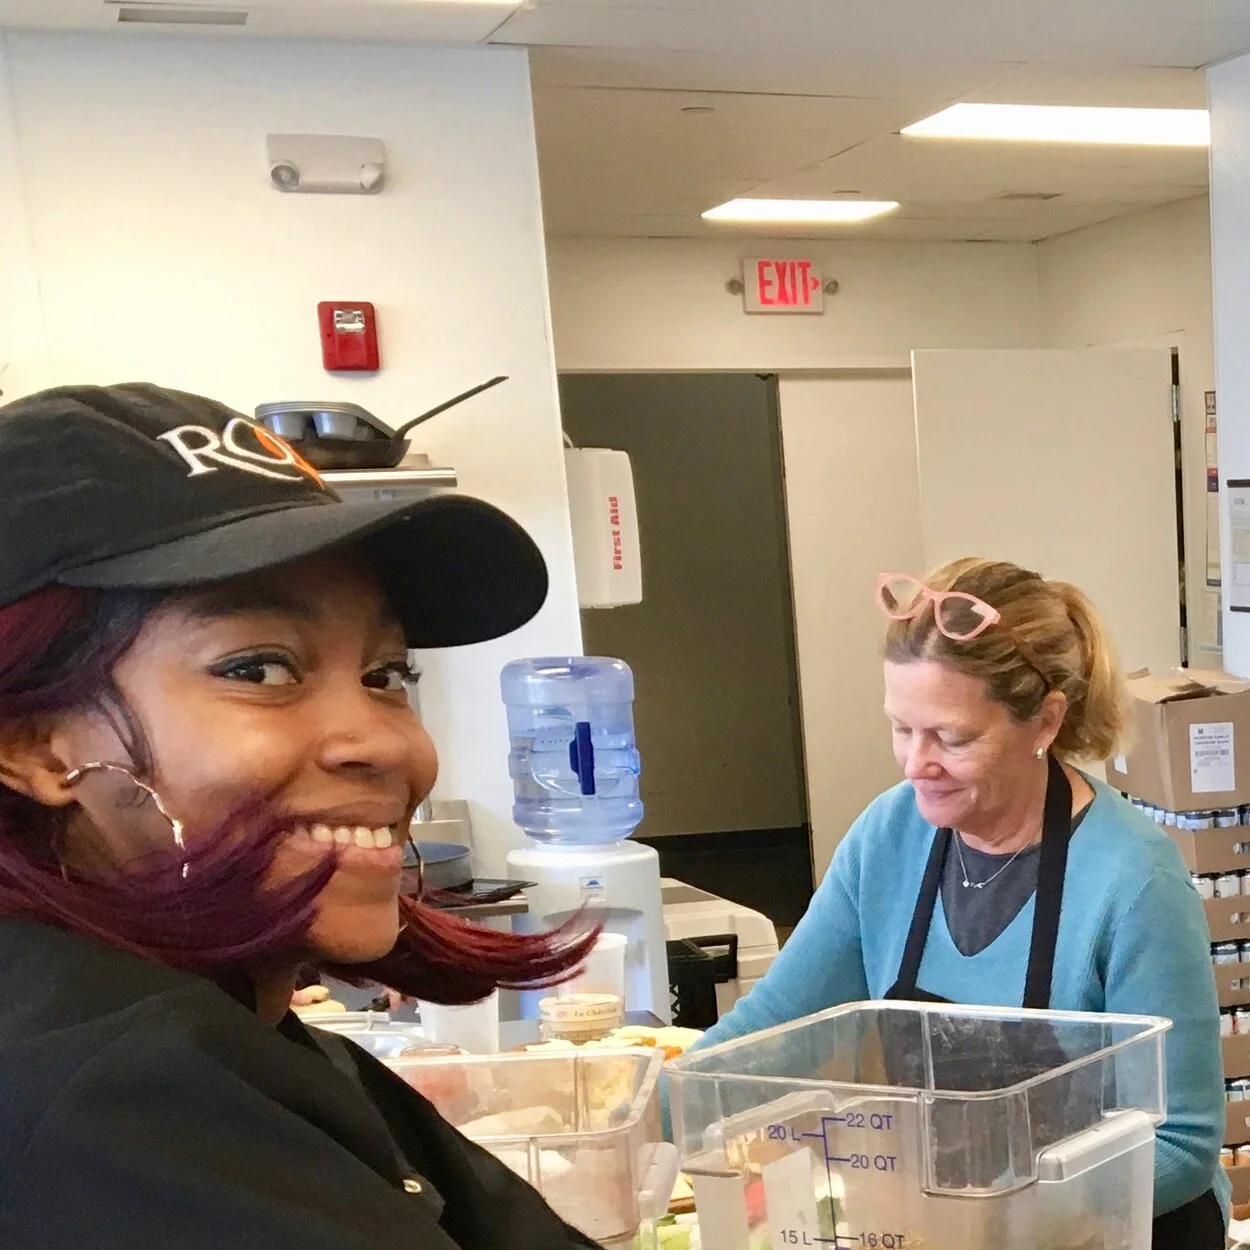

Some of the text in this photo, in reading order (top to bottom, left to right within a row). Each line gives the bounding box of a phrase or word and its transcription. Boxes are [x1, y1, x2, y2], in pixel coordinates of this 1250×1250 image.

[758, 261, 811, 305] EXIT
[608, 496, 622, 570] First Aid
[846, 1112, 893, 1130] 22 QT
[767, 1124, 801, 1141] 20 L
[851, 1154, 897, 1171] 20 QT
[780, 1230, 813, 1246] 15 L
[859, 1232, 905, 1249] 16 QT
